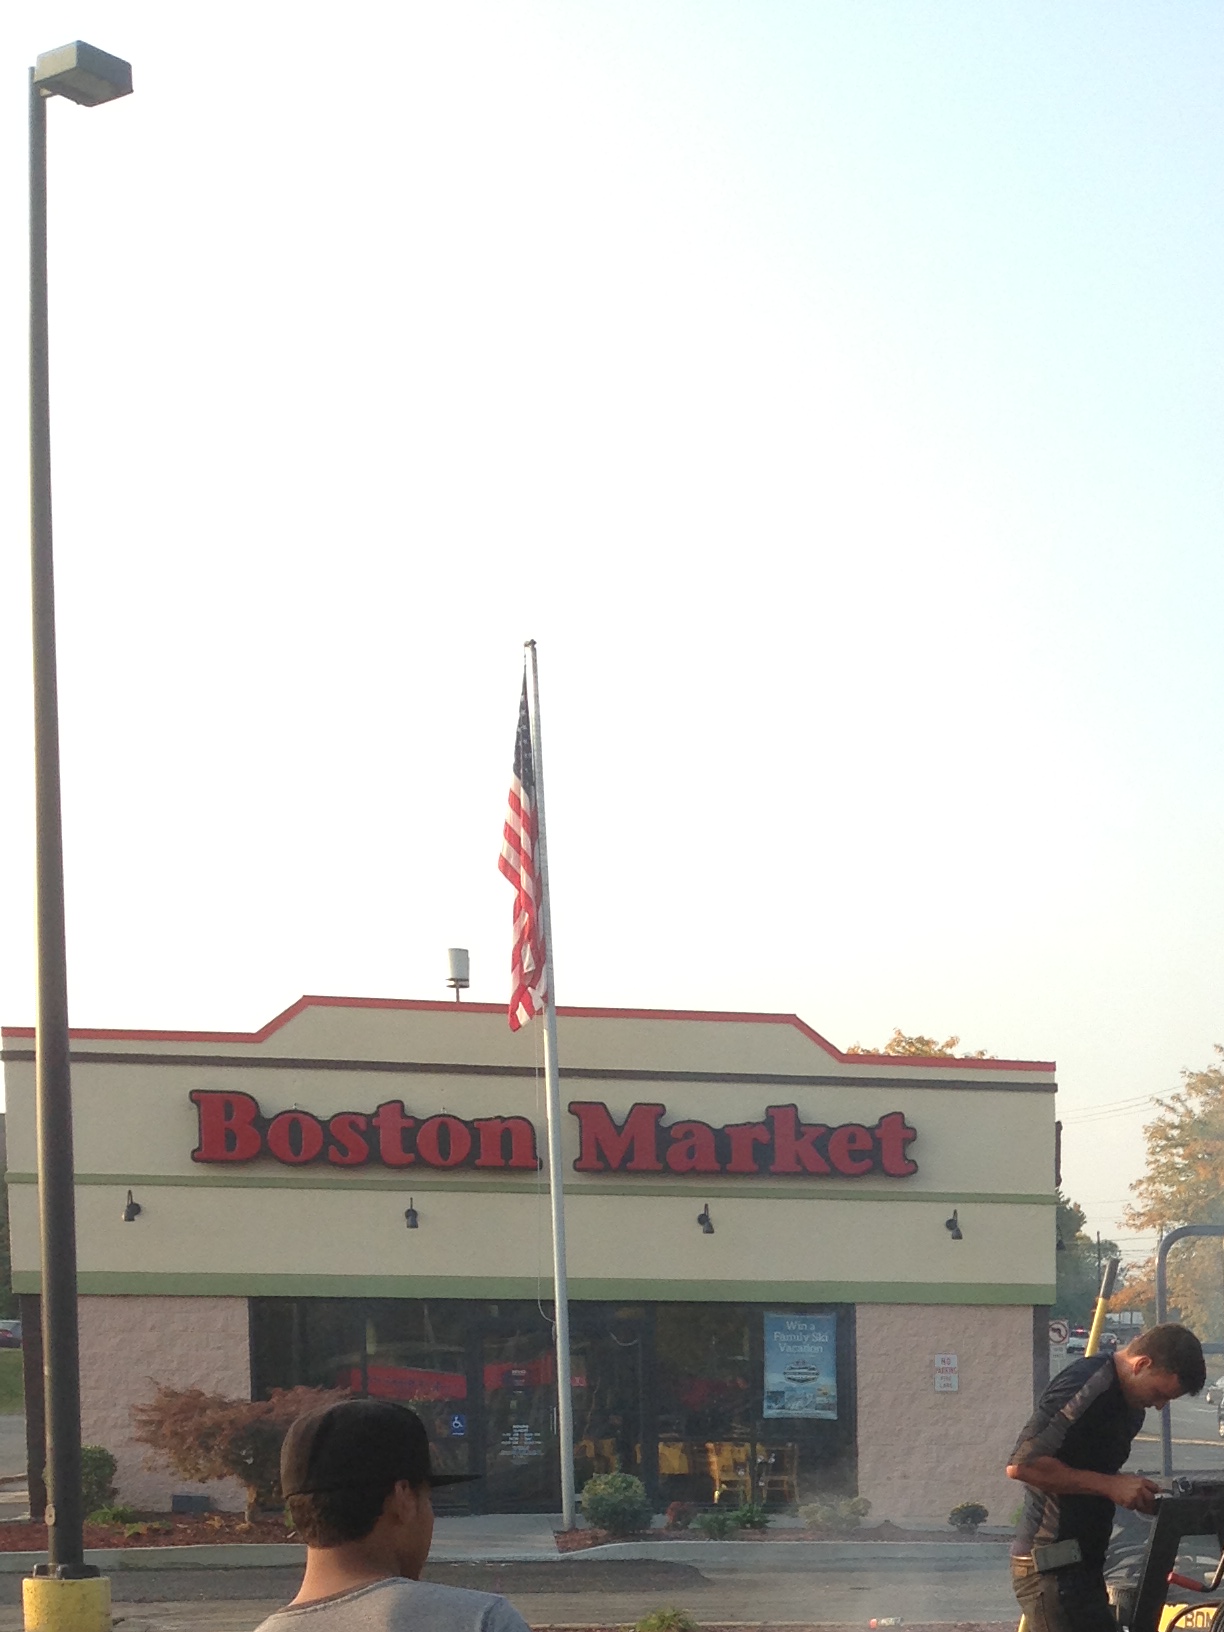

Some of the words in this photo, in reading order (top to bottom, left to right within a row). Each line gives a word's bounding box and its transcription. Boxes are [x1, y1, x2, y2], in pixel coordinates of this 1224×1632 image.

[189, 1089, 543, 1171] Boston
[568, 1101, 918, 1178] Market
[785, 1321, 807, 1331] Win
[773, 1332, 809, 1342] Family
[812, 1331, 829, 1343] Ski
[778, 1343, 824, 1354] Vacation
[941, 1357, 951, 1366] NO
